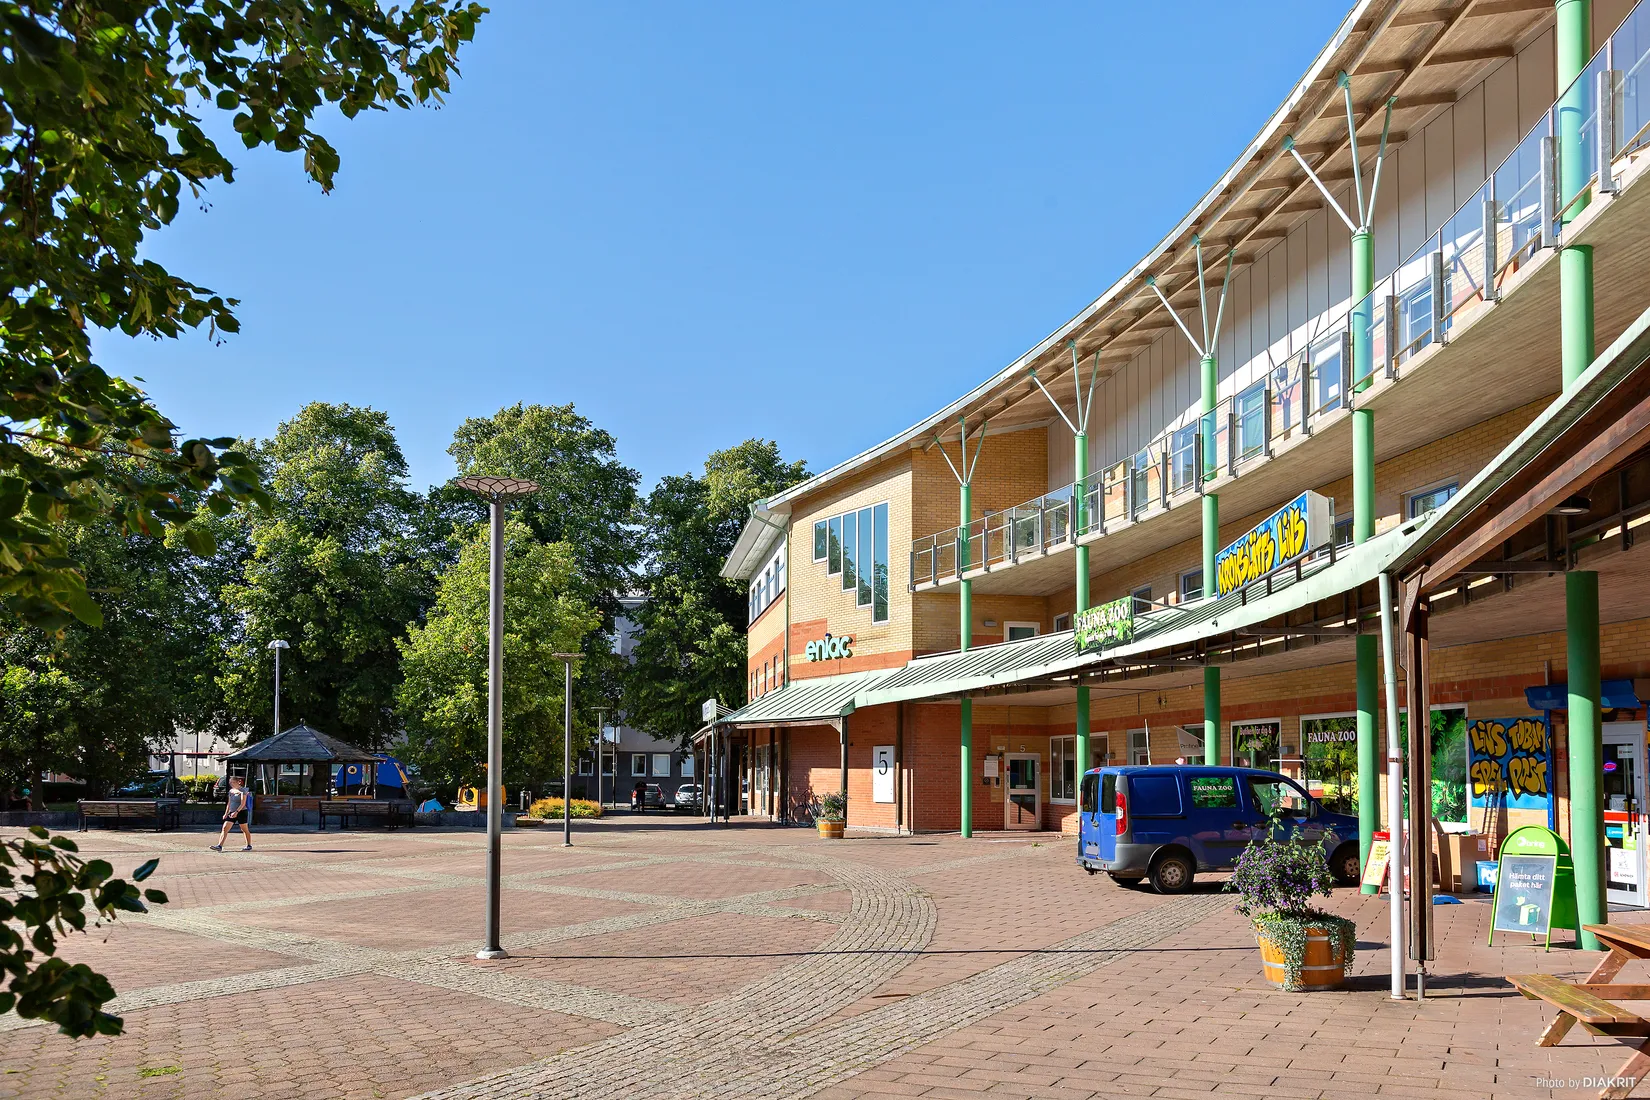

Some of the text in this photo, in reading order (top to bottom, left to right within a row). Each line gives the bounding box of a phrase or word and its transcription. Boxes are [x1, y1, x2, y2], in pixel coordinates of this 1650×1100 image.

[1077, 603, 1128, 632] FAUNA ZOO
[805, 633, 852, 662] eniac
[1307, 730, 1356, 743] FAUNA ZOO
[878, 751, 888, 775] 5
[1509, 757, 1547, 795] POST
[1531, 881, 1543, 889] här
[1532, 873, 1545, 881] ditt
